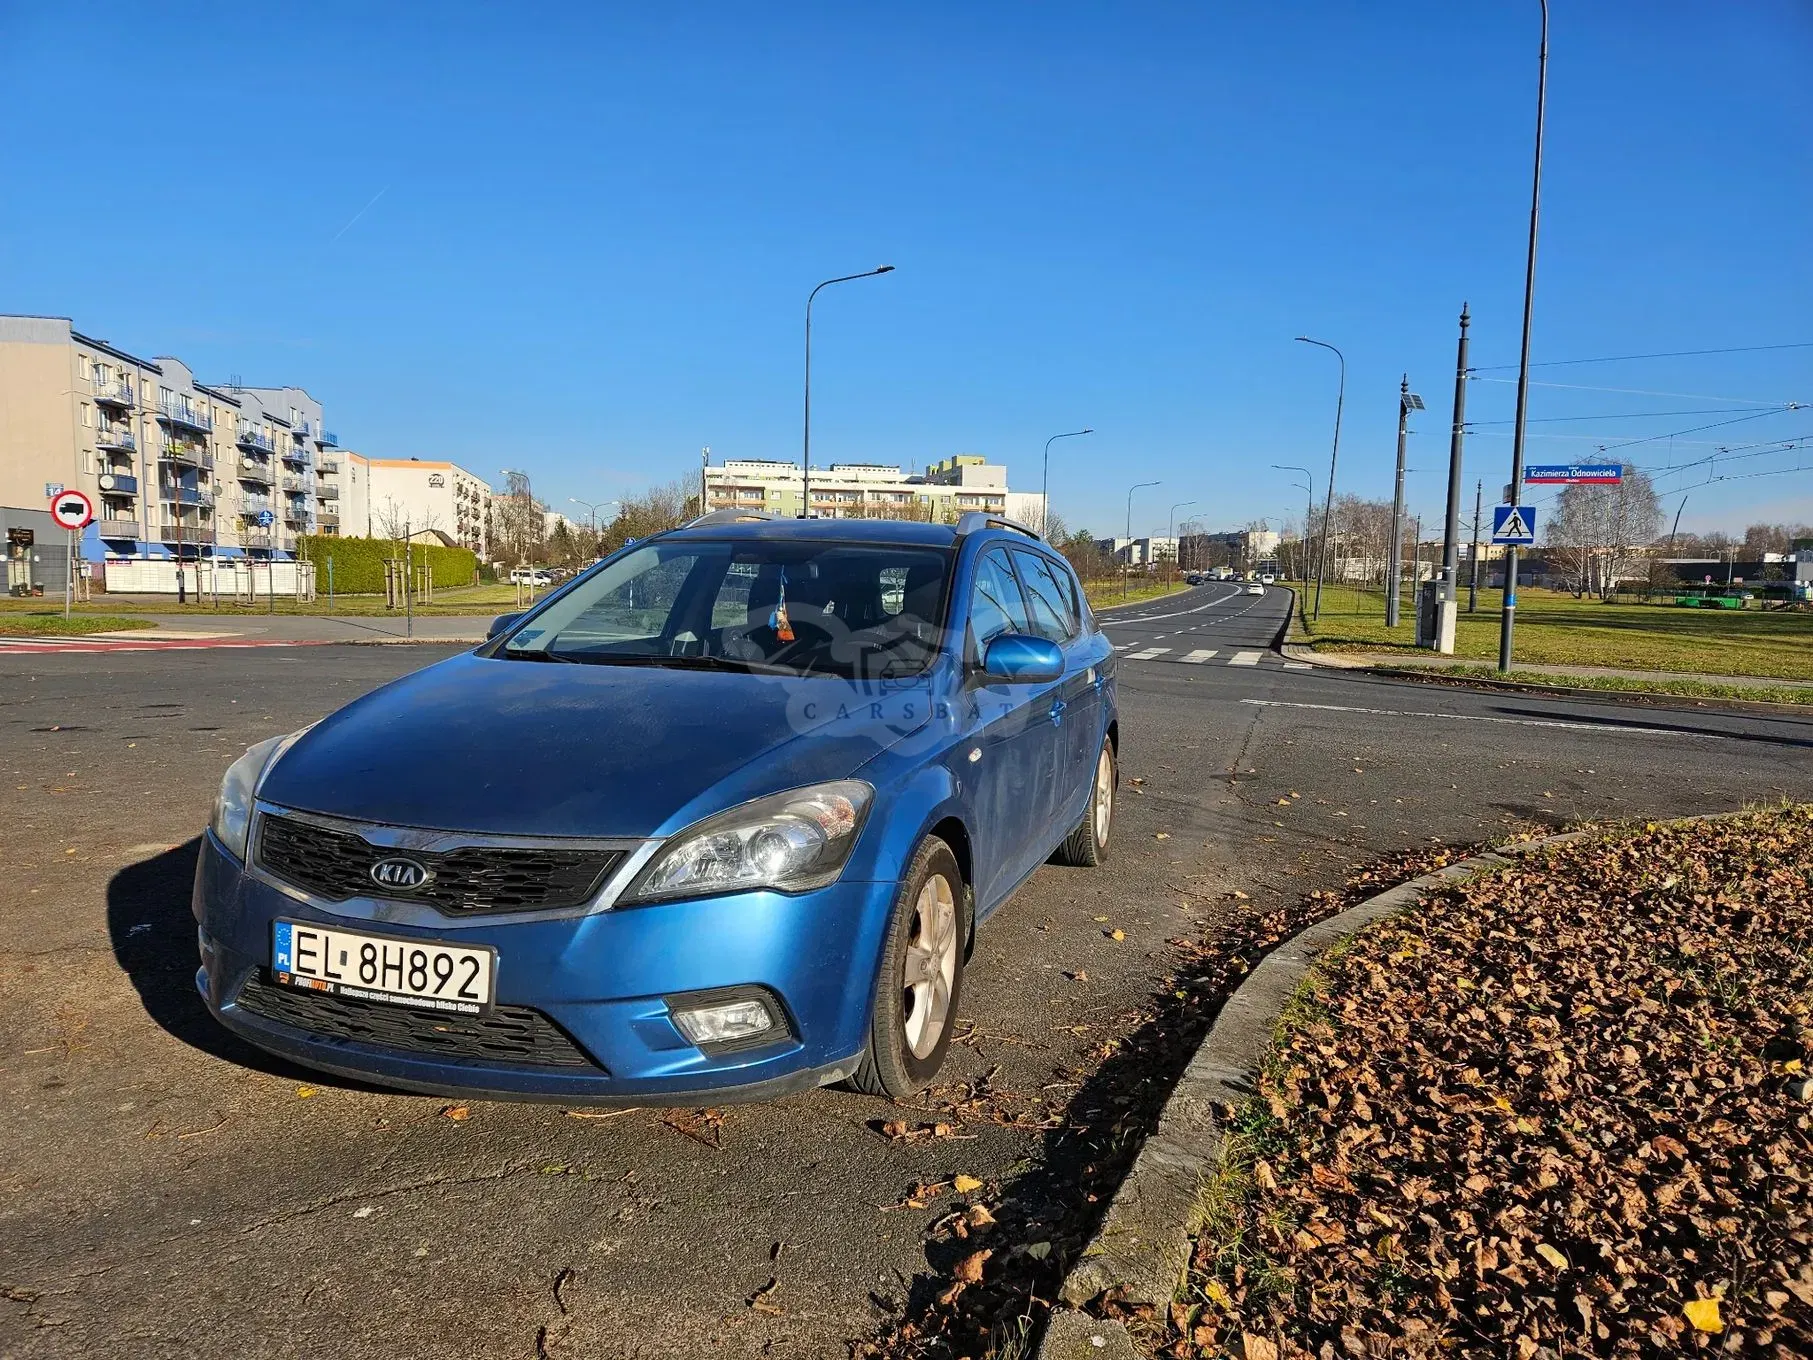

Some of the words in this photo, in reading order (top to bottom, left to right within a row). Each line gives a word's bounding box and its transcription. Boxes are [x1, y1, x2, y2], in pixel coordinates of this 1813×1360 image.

[1531, 469, 1569, 478] Kazimierza
[1571, 468, 1616, 478] Odnowiciela
[379, 863, 415, 884] KIA
[278, 952, 290, 966] PL
[297, 931, 342, 979] EL
[359, 943, 480, 999] 8H892
